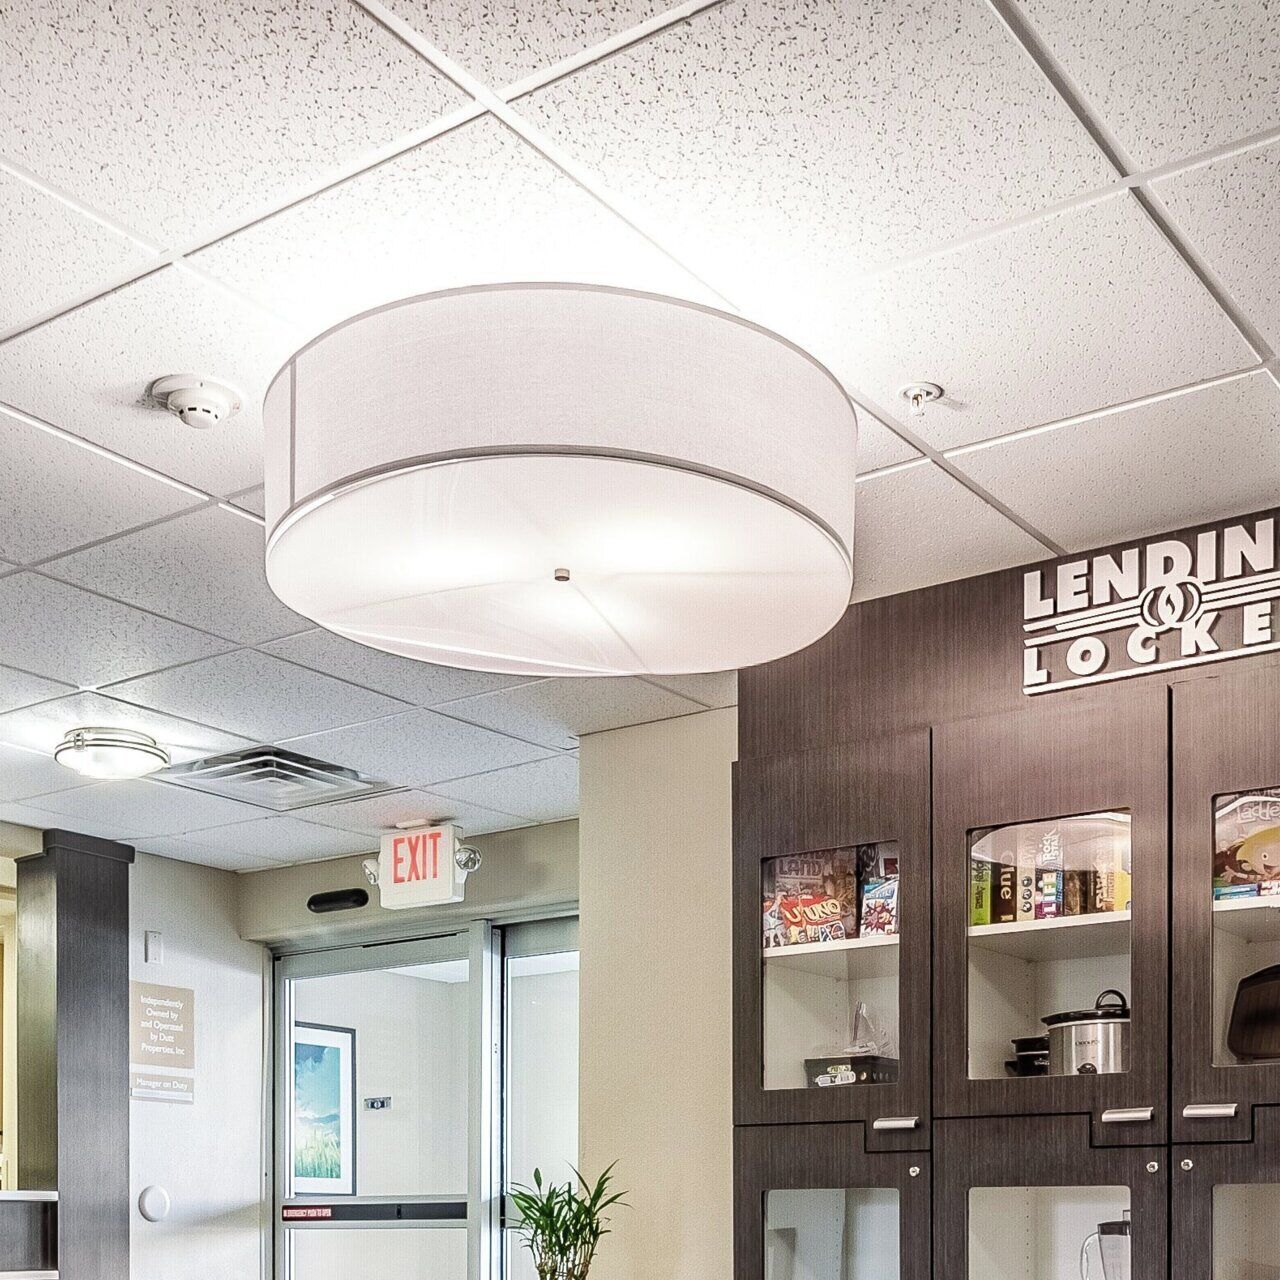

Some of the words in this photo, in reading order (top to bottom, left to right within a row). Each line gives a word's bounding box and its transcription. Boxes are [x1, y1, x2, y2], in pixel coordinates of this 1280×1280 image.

[392, 831, 442, 884] EXIT
[1042, 872, 1057, 912] LIFE
[803, 898, 841, 922] UNO
[170, 1010, 179, 1021] by
[150, 1031, 158, 1042] by
[136, 1078, 162, 1089] Manager
